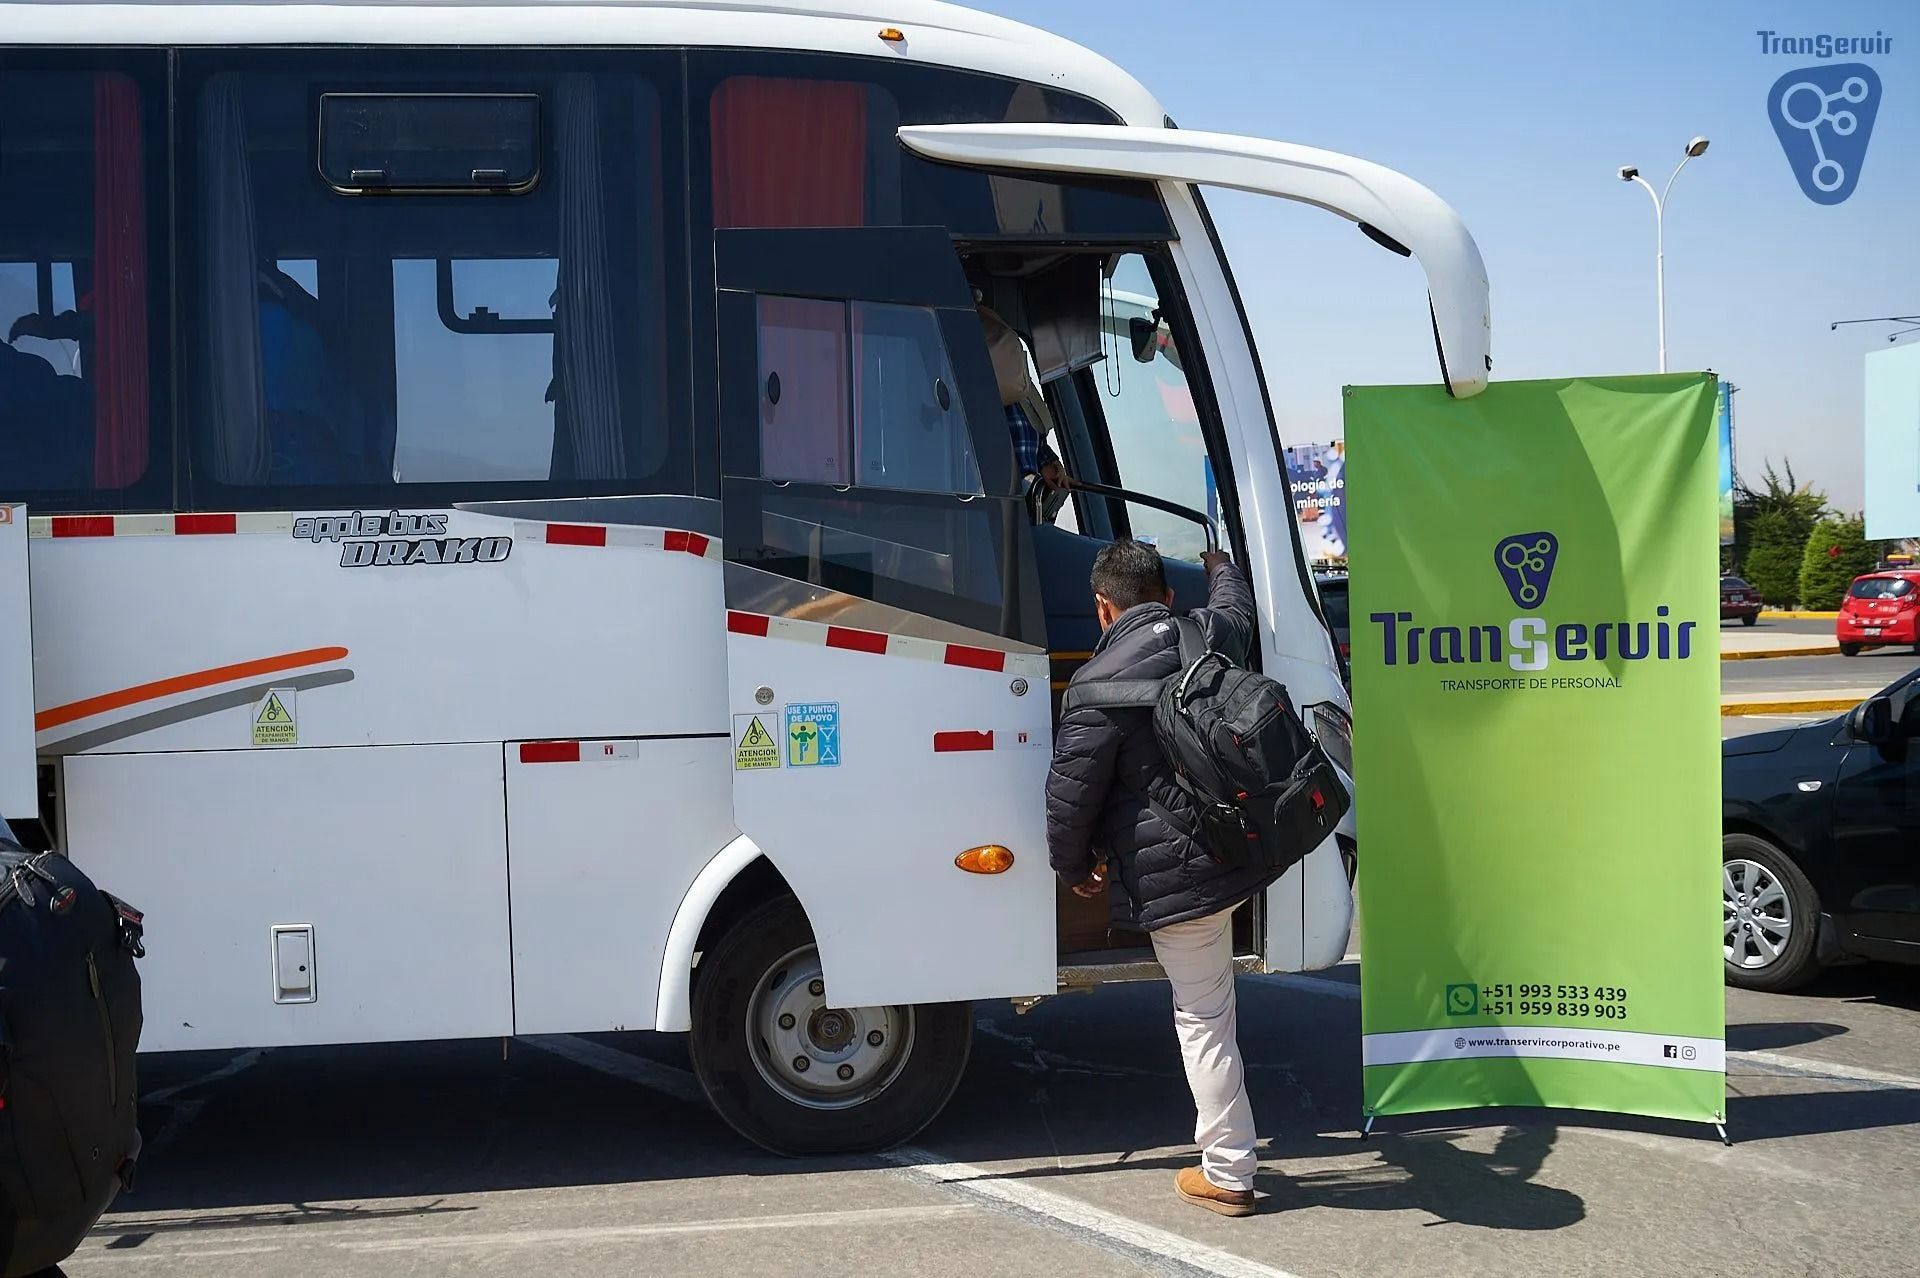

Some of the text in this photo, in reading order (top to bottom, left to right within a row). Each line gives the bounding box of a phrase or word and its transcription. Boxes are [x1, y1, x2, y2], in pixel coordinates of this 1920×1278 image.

[1328, 478, 1345, 489] de
[1296, 495, 1341, 509] minería
[293, 509, 448, 543] apple bus
[340, 537, 513, 567] DRAKO
[1441, 676, 1623, 691] TRANSPORTE DE PERSONAL
[787, 704, 837, 714] USE 3 PUNTOS
[805, 714, 833, 722] APOYO
[1482, 984, 1627, 1001] +51 993 533 439
[1482, 1001, 1627, 1020] +51 959 839 903
[1468, 1037, 1621, 1052] www.transervircorporativo.pe
